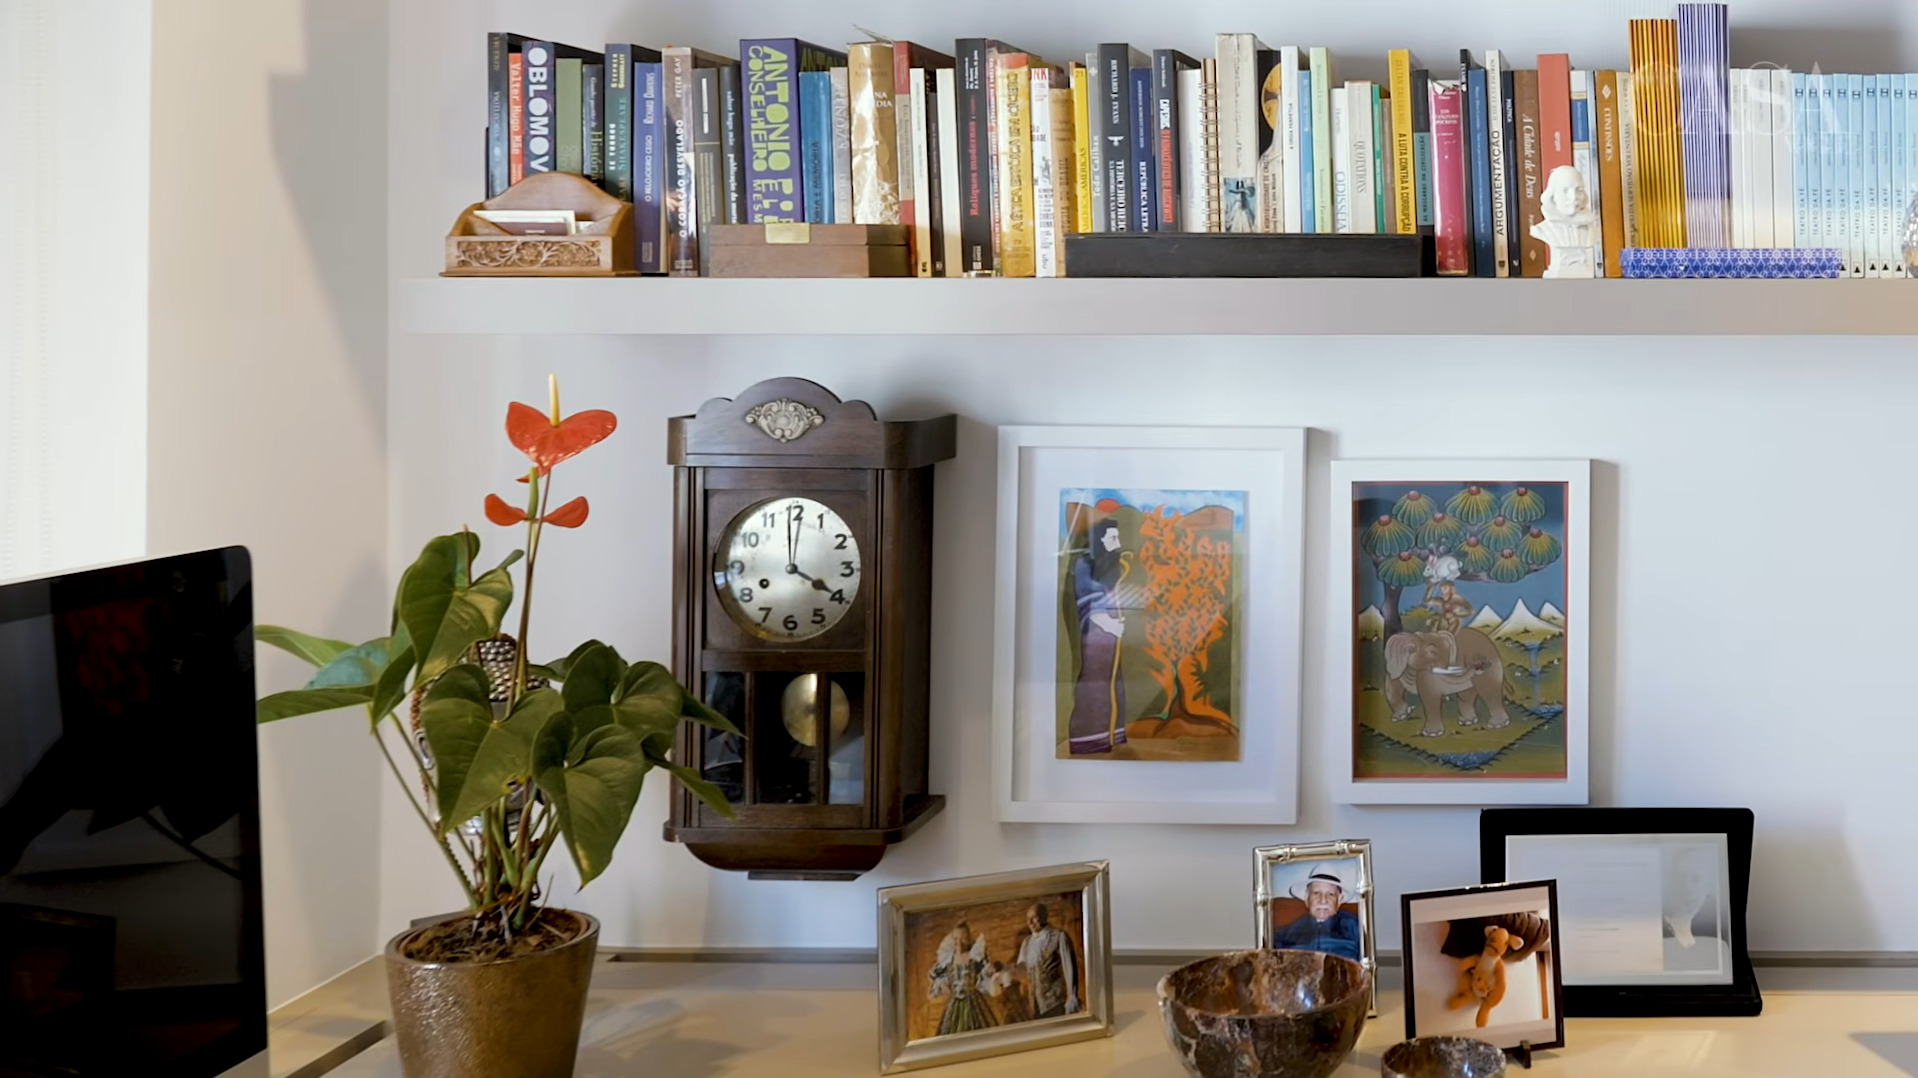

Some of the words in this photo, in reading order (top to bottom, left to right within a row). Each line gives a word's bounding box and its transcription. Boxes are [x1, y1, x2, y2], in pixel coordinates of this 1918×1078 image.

[511, 63, 521, 101] Valter
[1110, 59, 1118, 92] RICHARD
[510, 106, 521, 131] Hugo
[643, 100, 654, 124] RICHARD
[748, 46, 767, 171] CONSELHEIRO
[763, 46, 791, 171] ANTONIO
[1522, 114, 1533, 122] A
[512, 136, 522, 154] Mãe
[618, 97, 627, 170] SHAKESPEARE
[645, 135, 653, 154] CEGO
[968, 121, 978, 170] modernes
[1523, 125, 1535, 157] Cidade
[1604, 107, 1613, 162] CONFISSÕES
[676, 119, 685, 175] DESVELADO
[1399, 138, 1407, 156] LUTA
[1354, 141, 1367, 193] QUOTATIONS
[1399, 157, 1409, 184] CONTRA
[1525, 160, 1535, 172] de
[969, 172, 980, 216] Reliques
[1116, 160, 1125, 207] TERCEIRO
[1139, 161, 1148, 205] REPÚBLICA
[1491, 130, 1505, 236] ARGUMENTAÇÃO
[1525, 175, 1536, 199] Deus
[676, 179, 687, 226] CORAÇÃO
[753, 180, 763, 222] MESM
[1399, 192, 1411, 231] CORRUPÇÃO
[1117, 208, 1127, 232] REIC
[1140, 207, 1149, 232] LETRA
[761, 513, 775, 528] 11
[786, 505, 804, 521] 12
[818, 513, 824, 529] 1
[741, 532, 759, 548] 10
[834, 534, 847, 549] 2
[730, 560, 745, 575] 9
[840, 561, 854, 577] 3
[739, 588, 753, 602] 8
[829, 589, 845, 604] 4
[758, 607, 772, 622] 7
[783, 615, 797, 630] 6
[811, 608, 826, 624] 5
